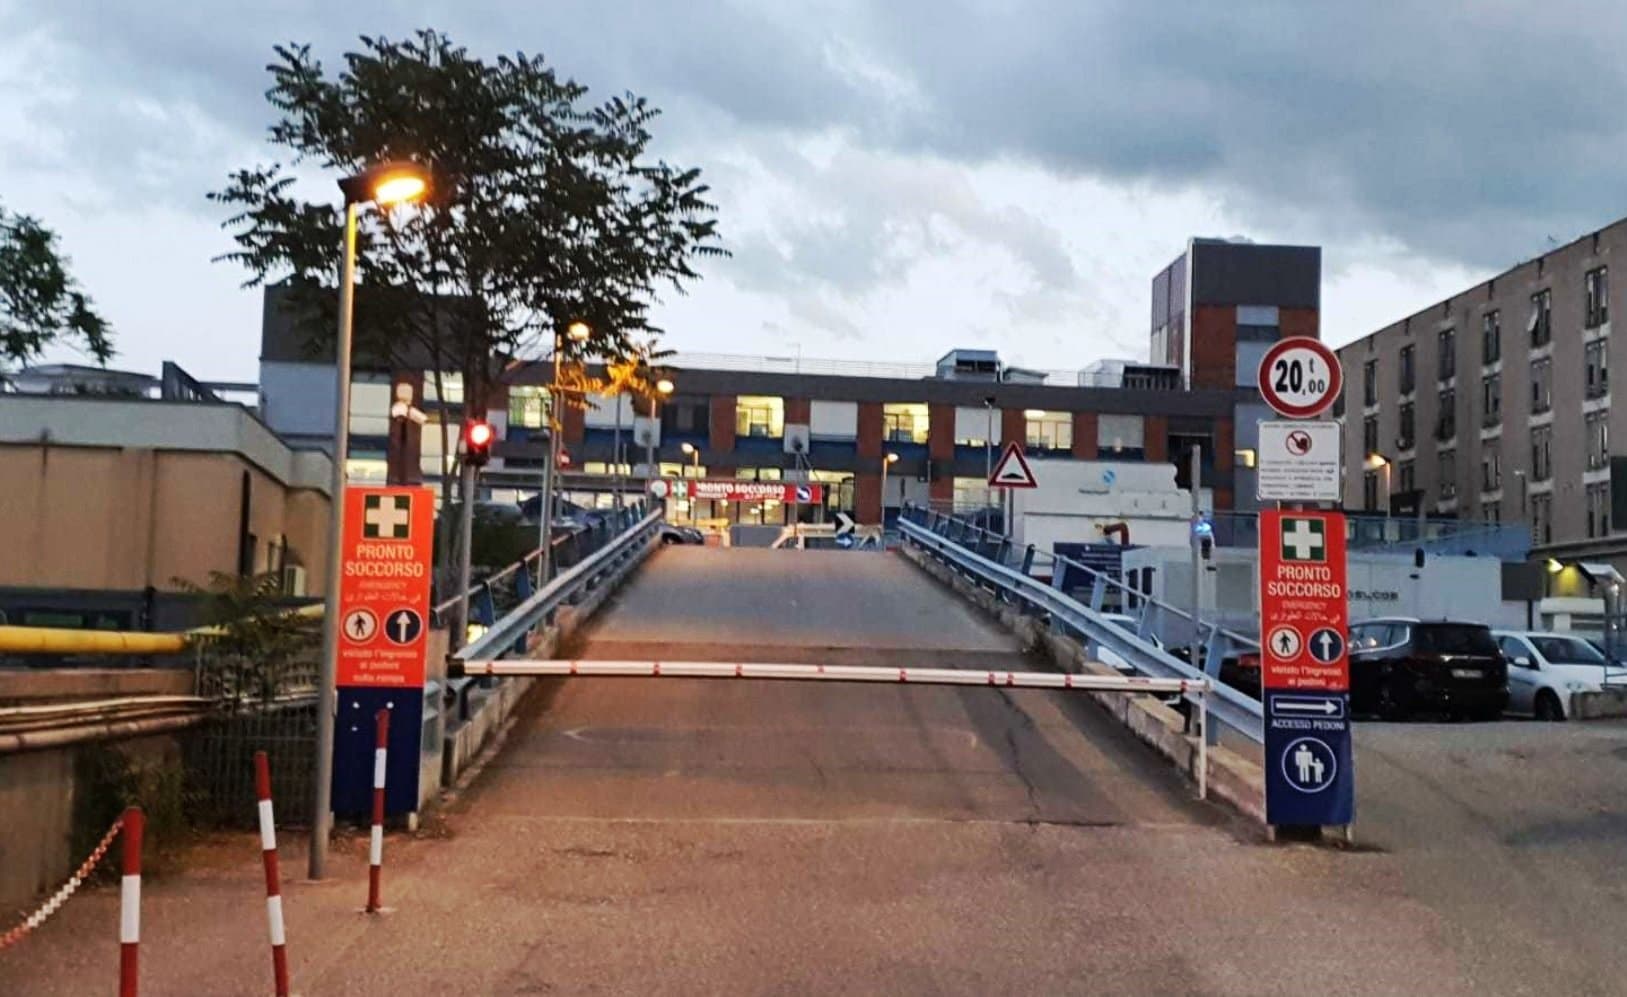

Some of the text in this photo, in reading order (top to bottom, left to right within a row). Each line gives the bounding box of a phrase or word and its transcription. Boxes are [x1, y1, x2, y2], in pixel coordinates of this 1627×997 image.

[735, 483, 785, 495] SOCCORSO
[356, 543, 414, 561] PRONTO
[345, 560, 424, 578] SOCCORSO
[1277, 564, 1332, 581] PRONTO
[1267, 580, 1341, 598] SOCCORSO
[1271, 719, 1345, 731] ACCESSO PEDONI
